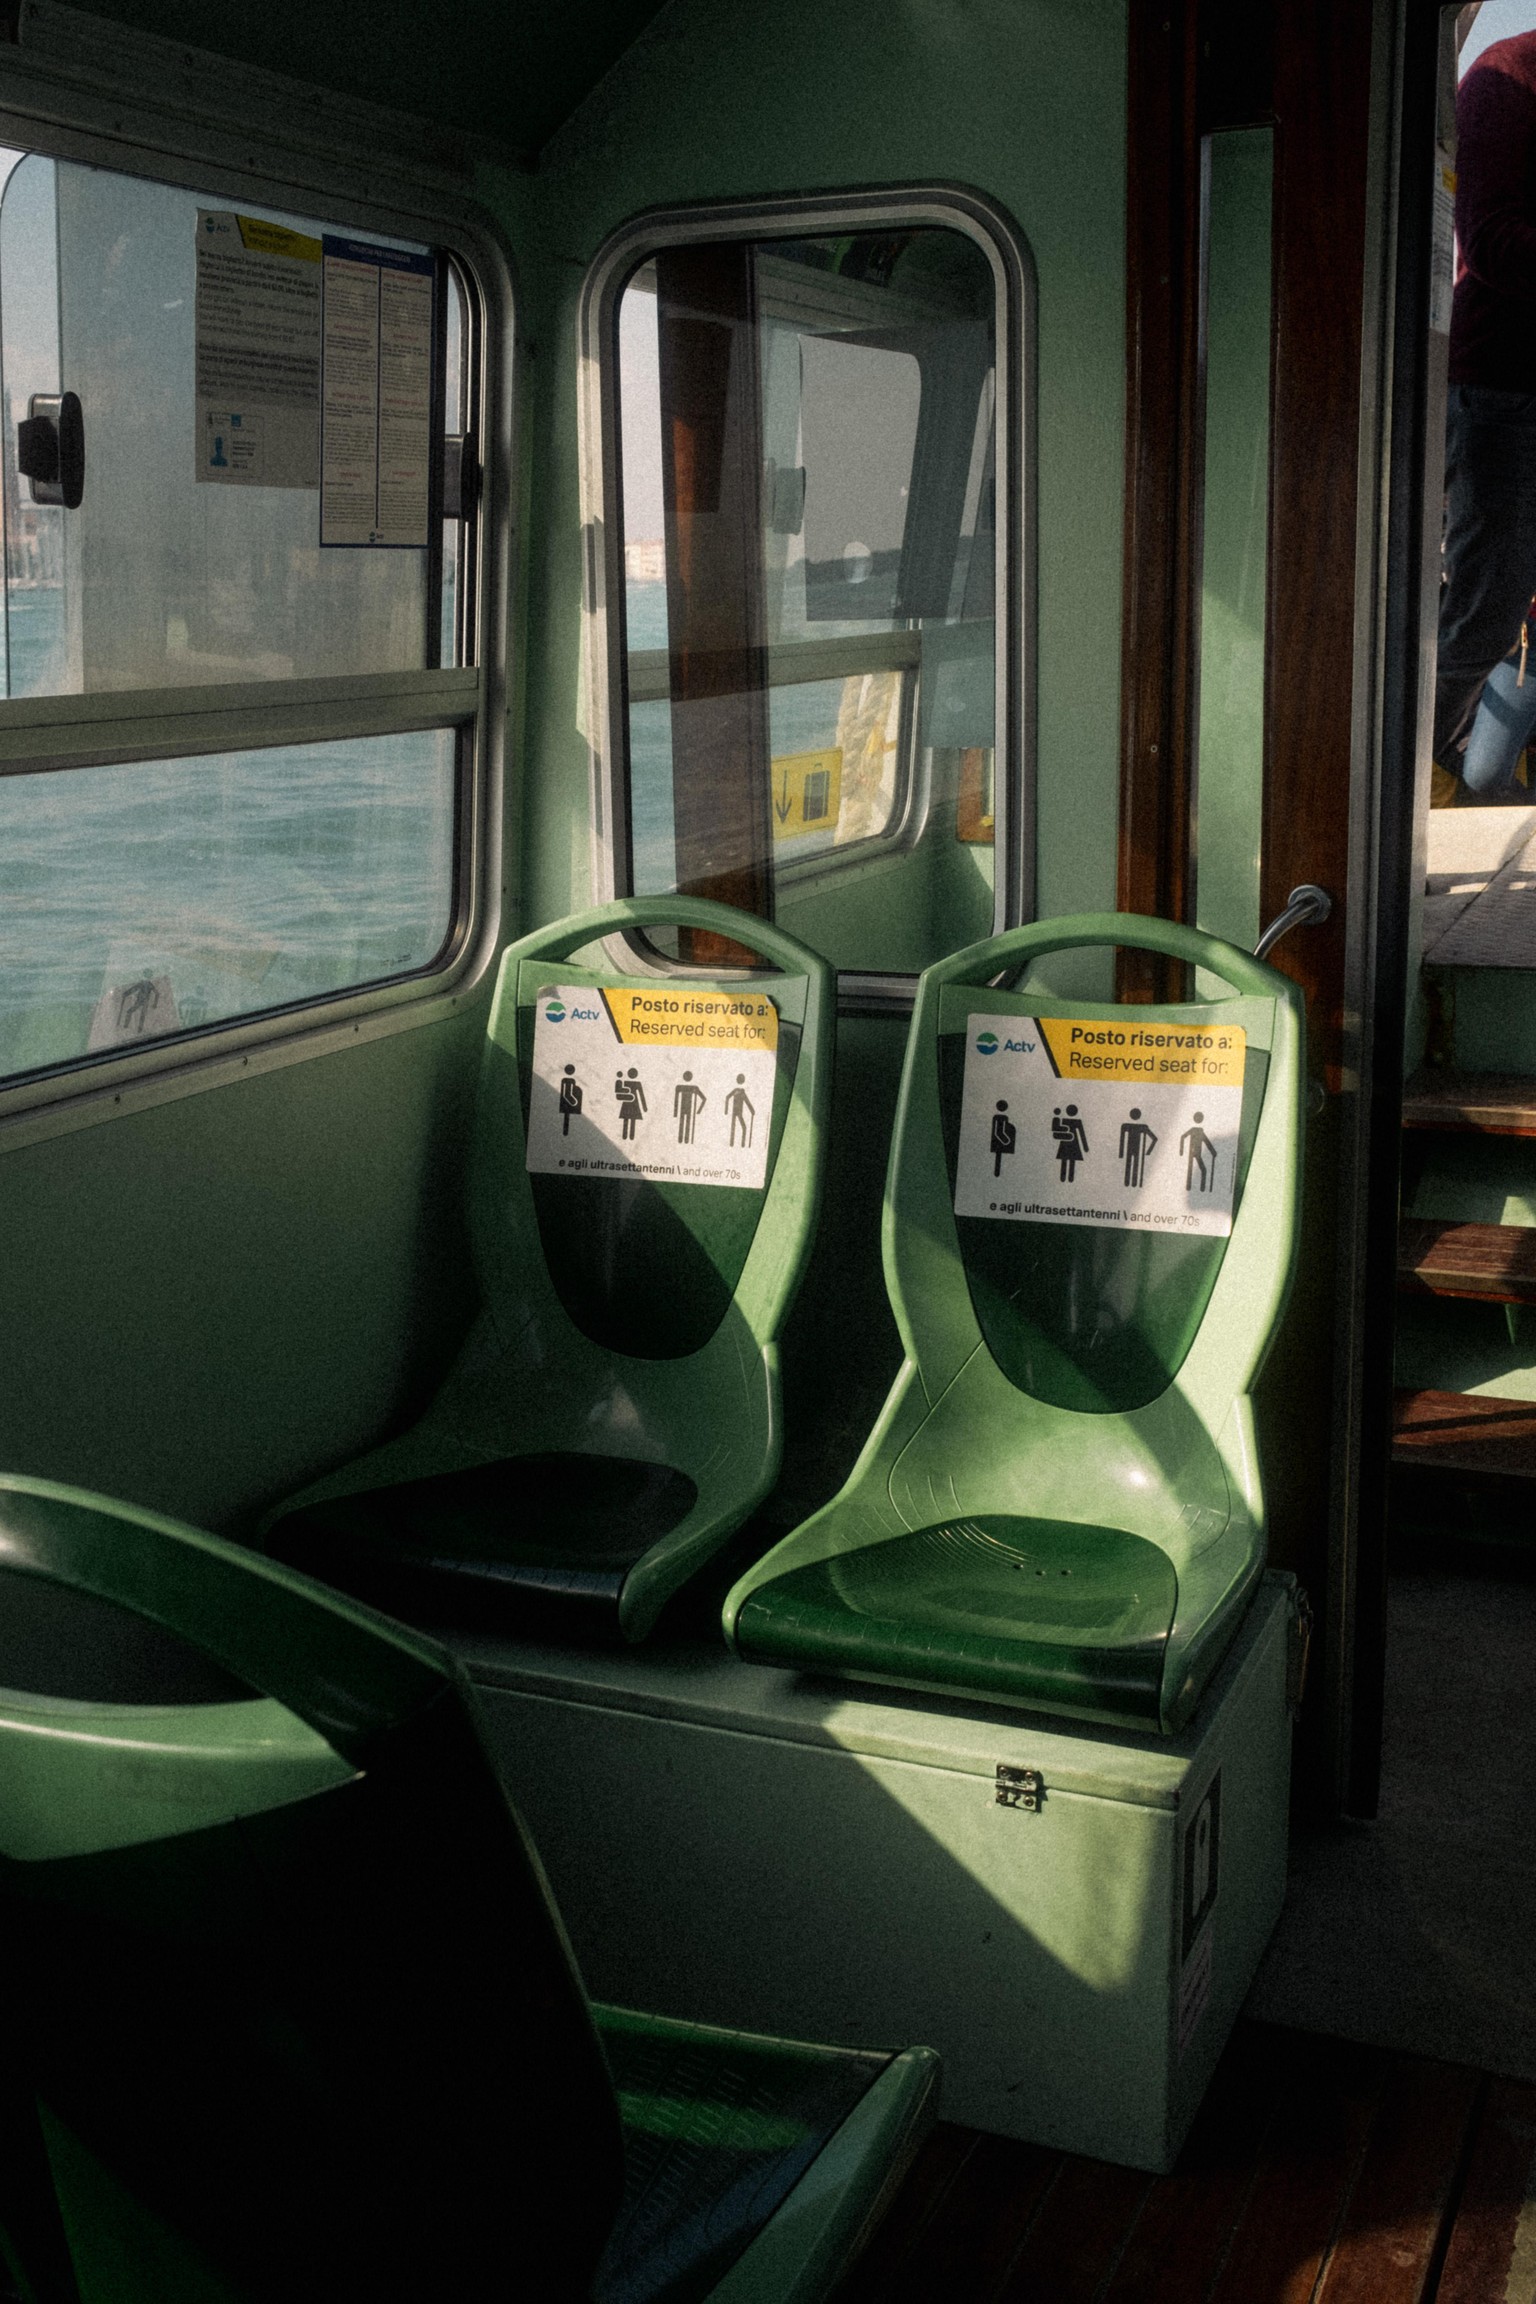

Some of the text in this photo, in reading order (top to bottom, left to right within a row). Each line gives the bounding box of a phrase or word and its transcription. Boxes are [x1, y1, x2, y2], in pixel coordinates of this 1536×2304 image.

[570, 1007, 600, 1021] Actv
[631, 996, 769, 1016] Posto riservato a:
[630, 1019, 766, 1039] Reserved seat for:
[1070, 1027, 1233, 1050] Posto riservato a:
[1003, 1039, 1036, 1053] Actv
[1069, 1052, 1229, 1074] Reserved seat for:
[558, 1158, 565, 1168] e
[567, 1157, 588, 1170] agli
[590, 1160, 675, 1175] ultrasettantenni
[682, 1167, 701, 1177] and
[702, 1169, 723, 1178] over
[725, 1168, 741, 1179] 70s
[989, 1201, 997, 1212] e
[999, 1200, 1022, 1214] agli
[1024, 1203, 1121, 1220] ultrasettantenni
[1130, 1211, 1152, 1223] and
[1153, 1213, 1178, 1225] over
[1180, 1214, 1201, 1227] 70s
